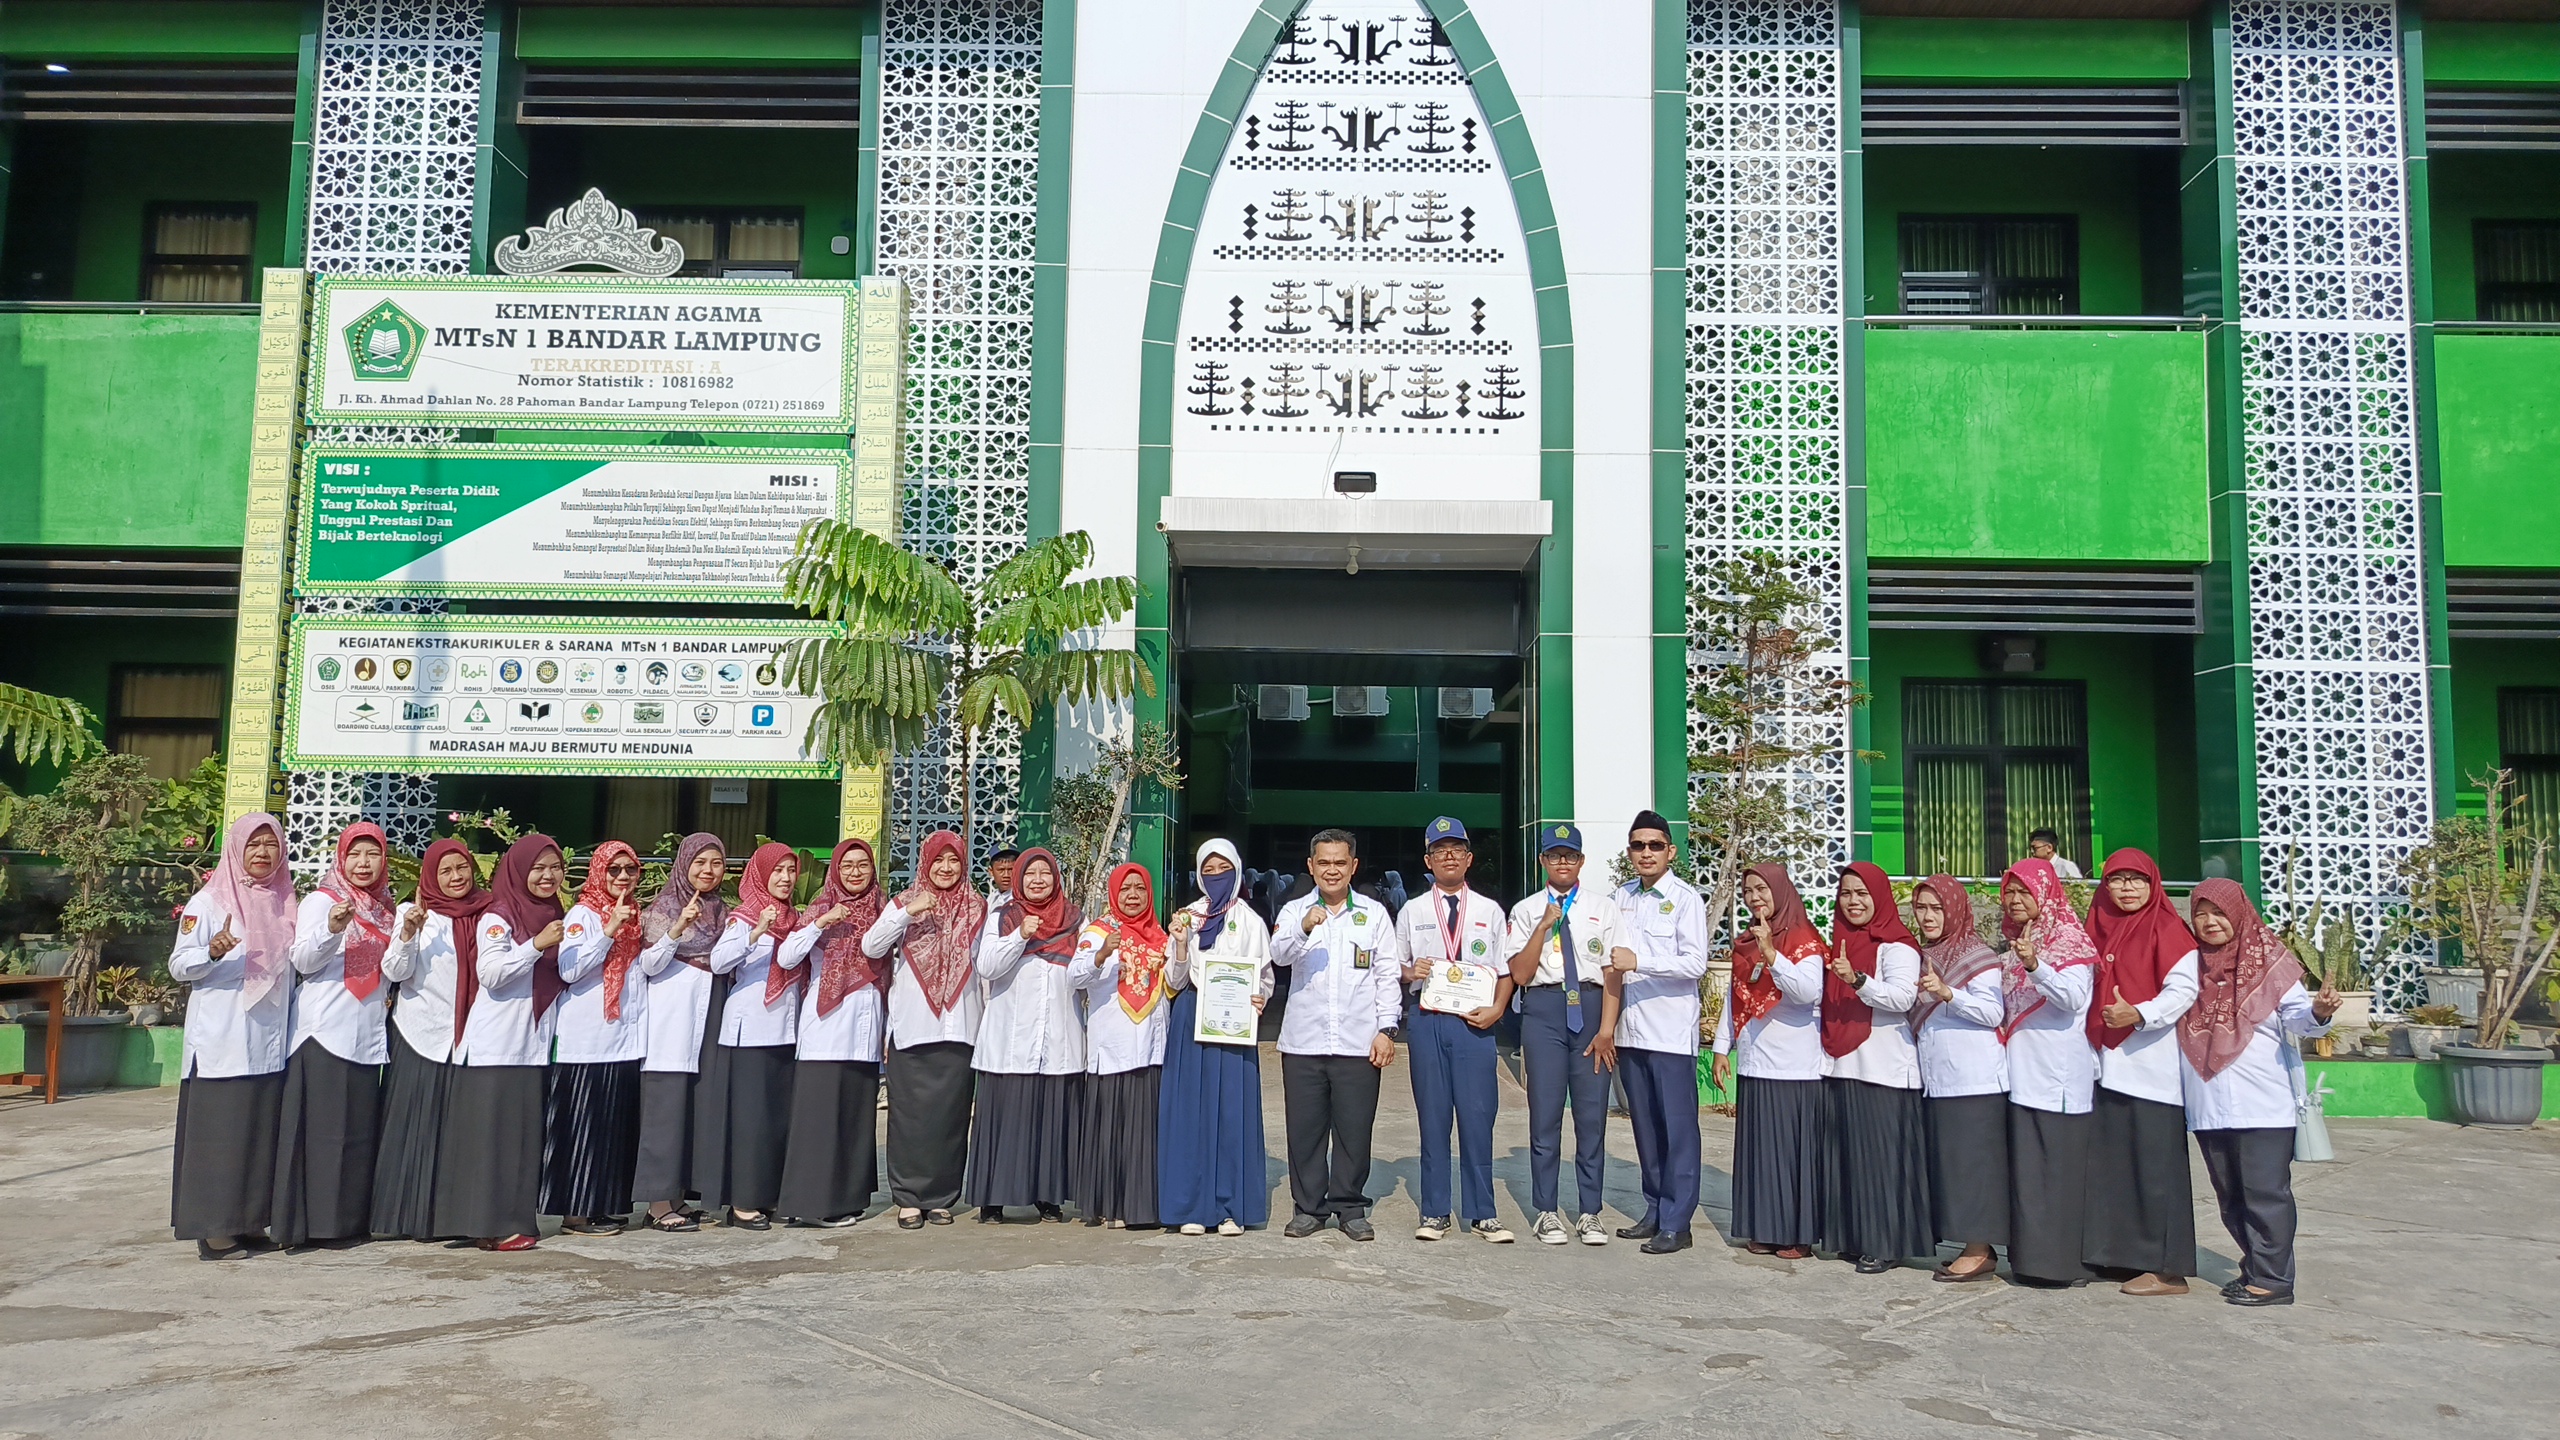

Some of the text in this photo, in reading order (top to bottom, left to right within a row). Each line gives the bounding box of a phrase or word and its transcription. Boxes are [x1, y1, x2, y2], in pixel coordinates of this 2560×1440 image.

[495, 303, 762, 322] KEMENTERIAN AGAMA
[434, 327, 822, 352] MTsN 1 BANDAR LAMPUNG
[531, 358, 693, 373] TERAKREDITASI
[708, 361, 723, 375] A
[518, 374, 574, 387] Nomor
[577, 375, 644, 388] Statistik
[662, 376, 734, 389] 10816982
[339, 394, 825, 411] Jl. Kh. Ahmad Dahlan No. 28 Pahoman Bandar Lampung Telepon (0721) 251869
[323, 463, 371, 476] VISI :
[769, 475, 818, 487] MISI :
[321, 484, 500, 497] Terwujudnya Peserta Didik
[622, 489, 648, 497] Kesadaran
[650, 489, 676, 498] Beribadah
[734, 491, 748, 500] Islam
[750, 492, 766, 500] Dalam
[319, 499, 458, 513] Yang Kokoh Spritual,
[702, 505, 717, 515] Dapat
[319, 514, 453, 527] Unggul Prestasi Dan
[672, 517, 689, 526] Secara
[783, 520, 799, 528] Secara
[318, 530, 443, 544] Bijak Berteknologi
[720, 532, 731, 540] Dan
[750, 532, 767, 541] Dalam
[628, 544, 645, 553] Dalam
[544, 640, 554, 651] &
[559, 640, 613, 652] SARANA
[621, 641, 656, 653] MTsN
[662, 642, 667, 653] 1
[672, 642, 727, 653] BANDAR
[758, 709, 768, 722] P
[429, 741, 693, 755] MADRASAH MAJU BERMUTU MENDUNIA
